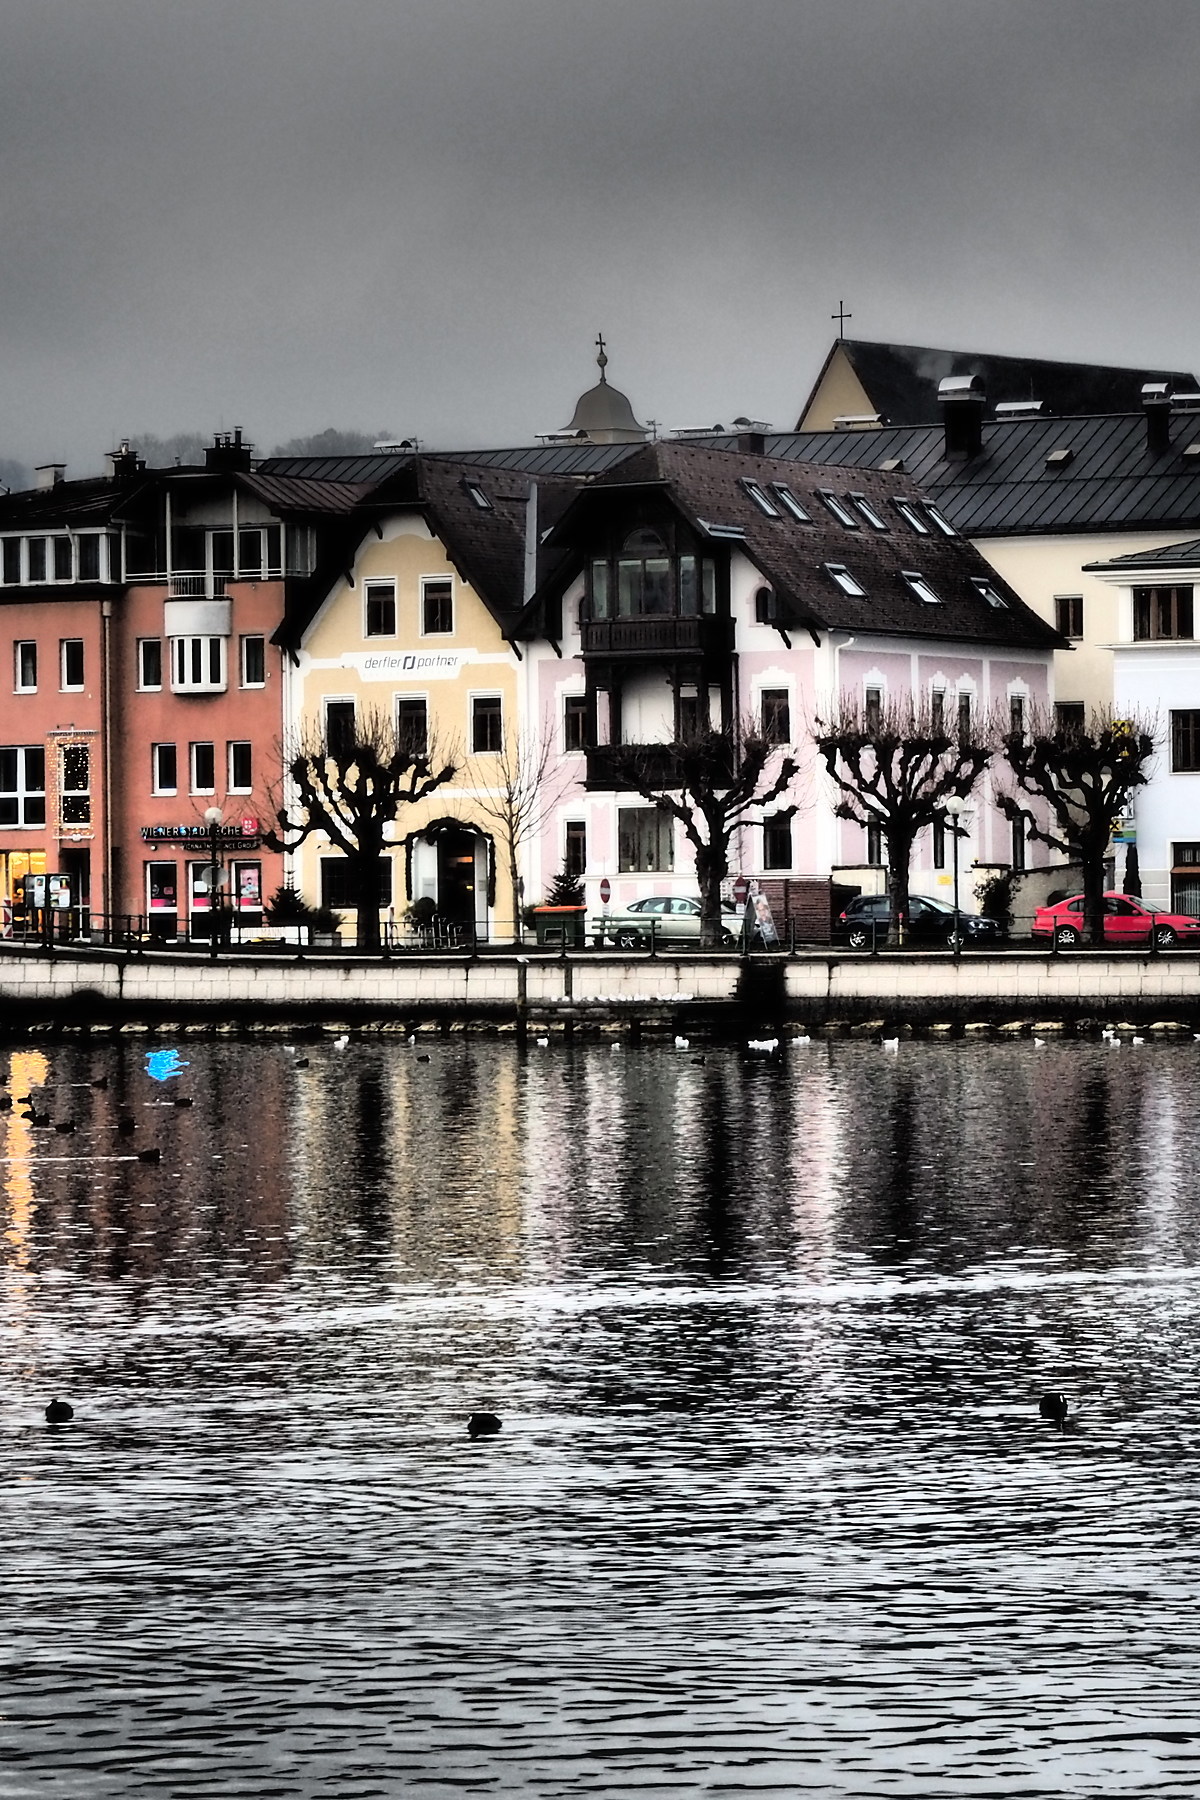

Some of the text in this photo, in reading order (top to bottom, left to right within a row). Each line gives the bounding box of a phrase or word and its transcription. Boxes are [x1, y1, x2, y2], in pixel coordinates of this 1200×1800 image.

[364, 654, 459, 670] derfler partner
[139, 826, 178, 837] WIENER
